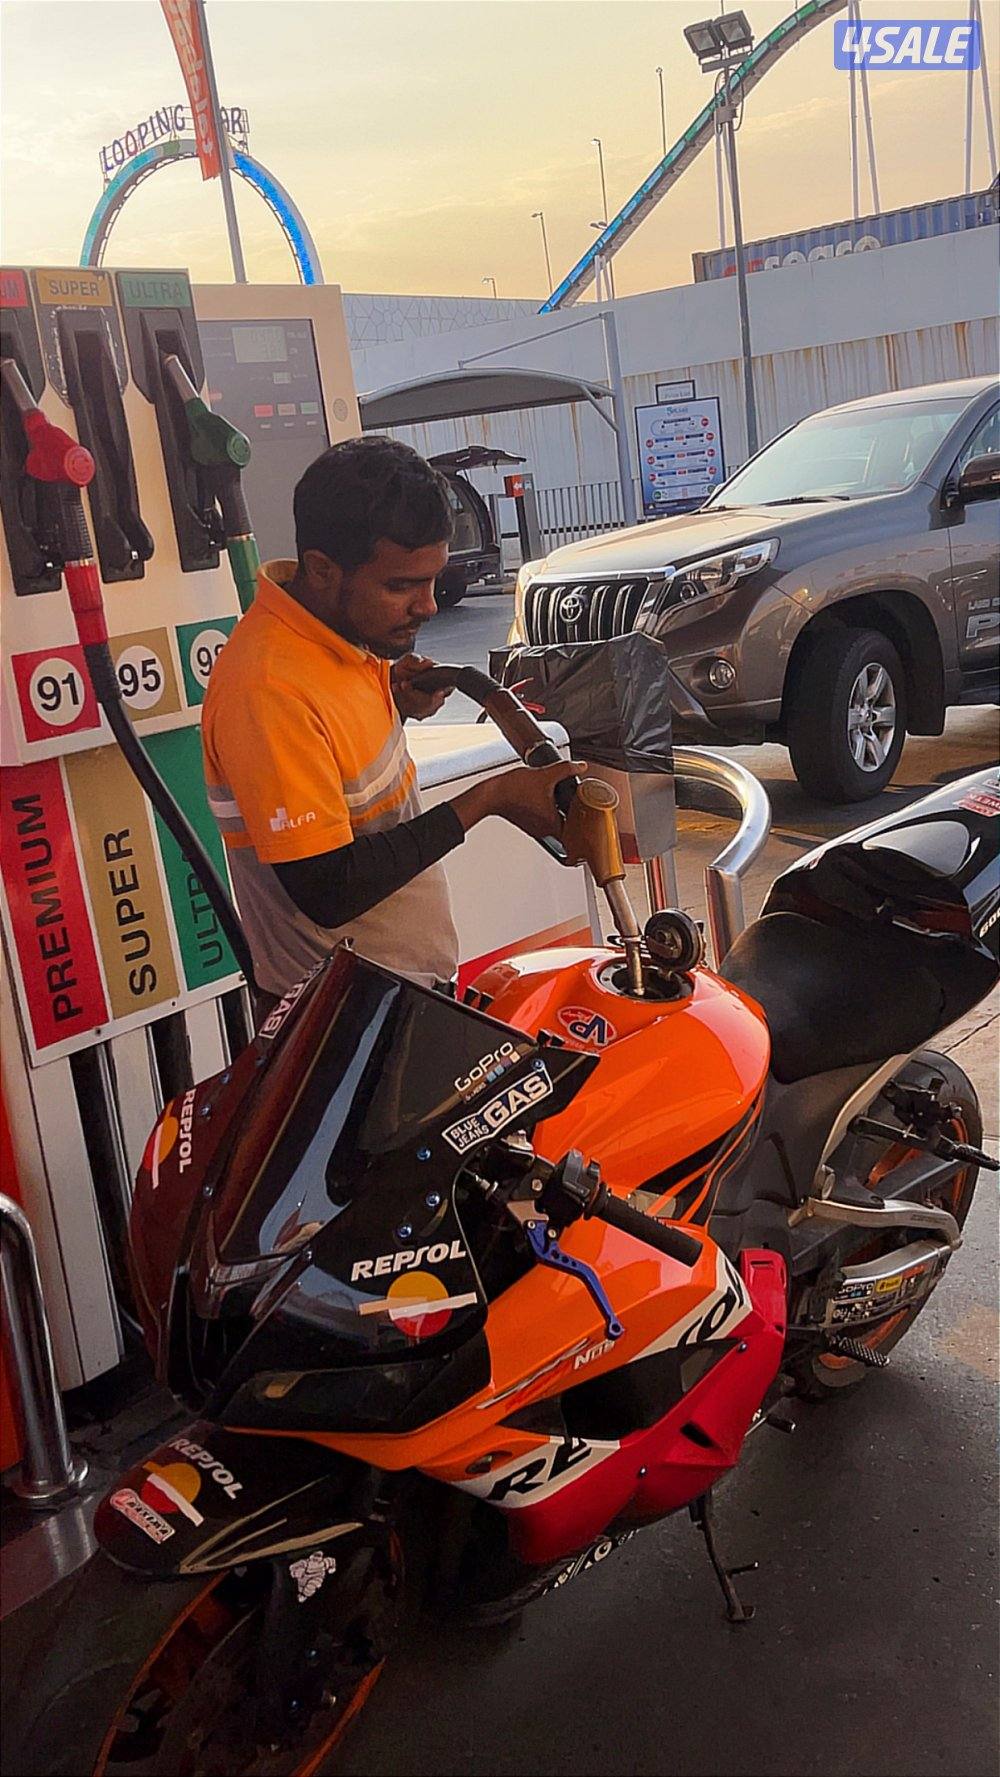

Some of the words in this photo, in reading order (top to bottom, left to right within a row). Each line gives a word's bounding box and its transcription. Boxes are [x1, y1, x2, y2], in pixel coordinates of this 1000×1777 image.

[102, 104, 186, 171] LOOPING
[49, 279, 100, 297] SUPER
[129, 281, 182, 299] ULTRA
[37, 673, 79, 711] 91
[118, 659, 162, 697] 95
[11, 794, 83, 1022] PREMIUM
[103, 828, 158, 996] SUPER
[181, 850, 223, 969] ULTR
[454, 1041, 514, 1092] GoPro
[483, 1075, 548, 1128] GAS
[178, 1088, 197, 1174] REPSOL
[450, 1117, 481, 1139] BLUE
[458, 1124, 490, 1148] JEANS
[350, 1239, 467, 1282] REPSOL
[168, 1438, 244, 1500] REPSOL
